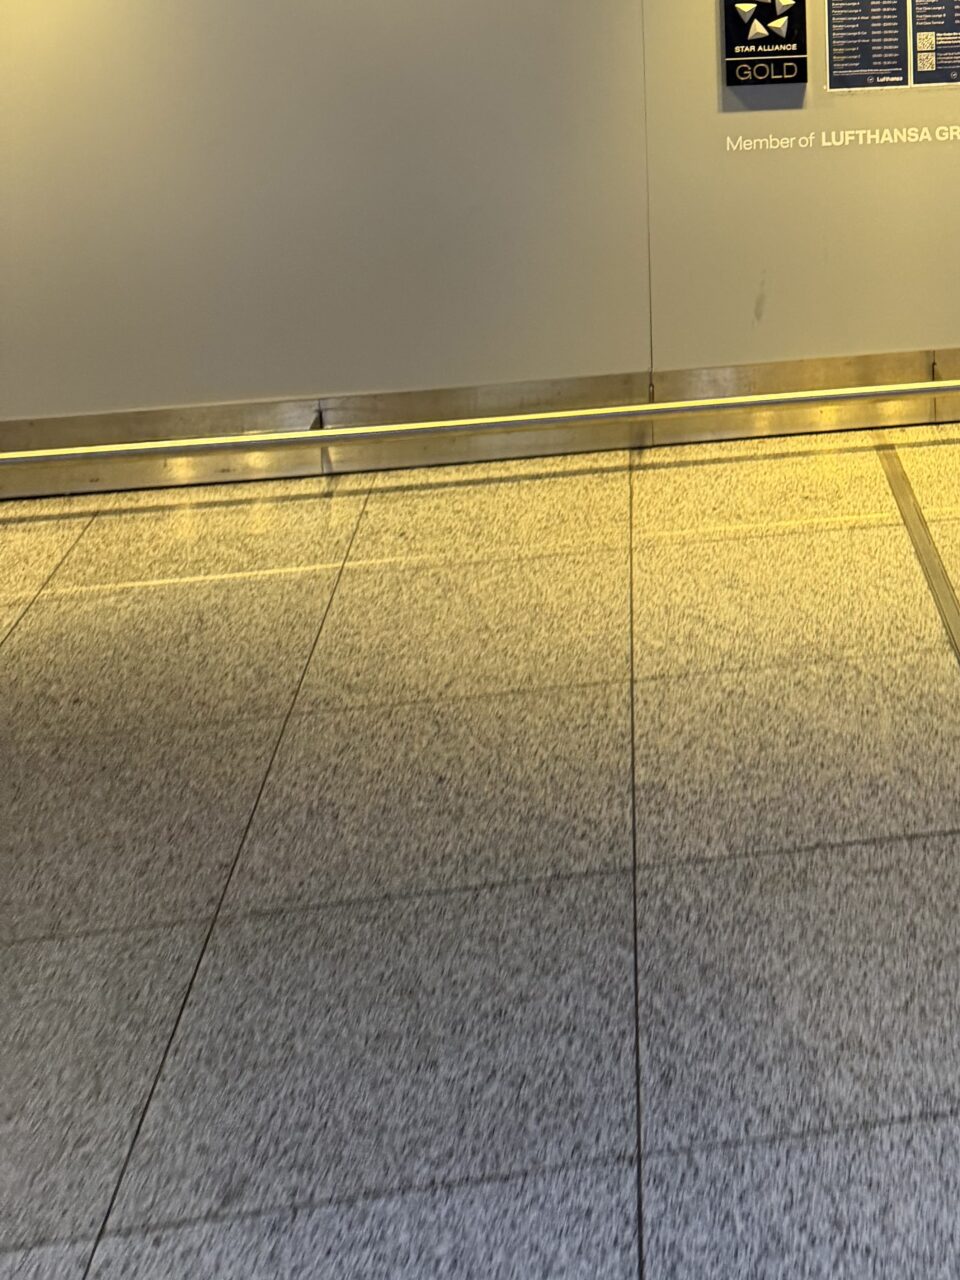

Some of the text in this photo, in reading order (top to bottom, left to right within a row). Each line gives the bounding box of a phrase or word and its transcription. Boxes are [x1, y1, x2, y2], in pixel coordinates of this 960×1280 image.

[734, 43, 798, 53] STAR ALLIANCE
[735, 61, 798, 81] GOLD
[726, 134, 795, 151] Member
[798, 132, 815, 148] of
[821, 126, 931, 147] LUFTHANSA
